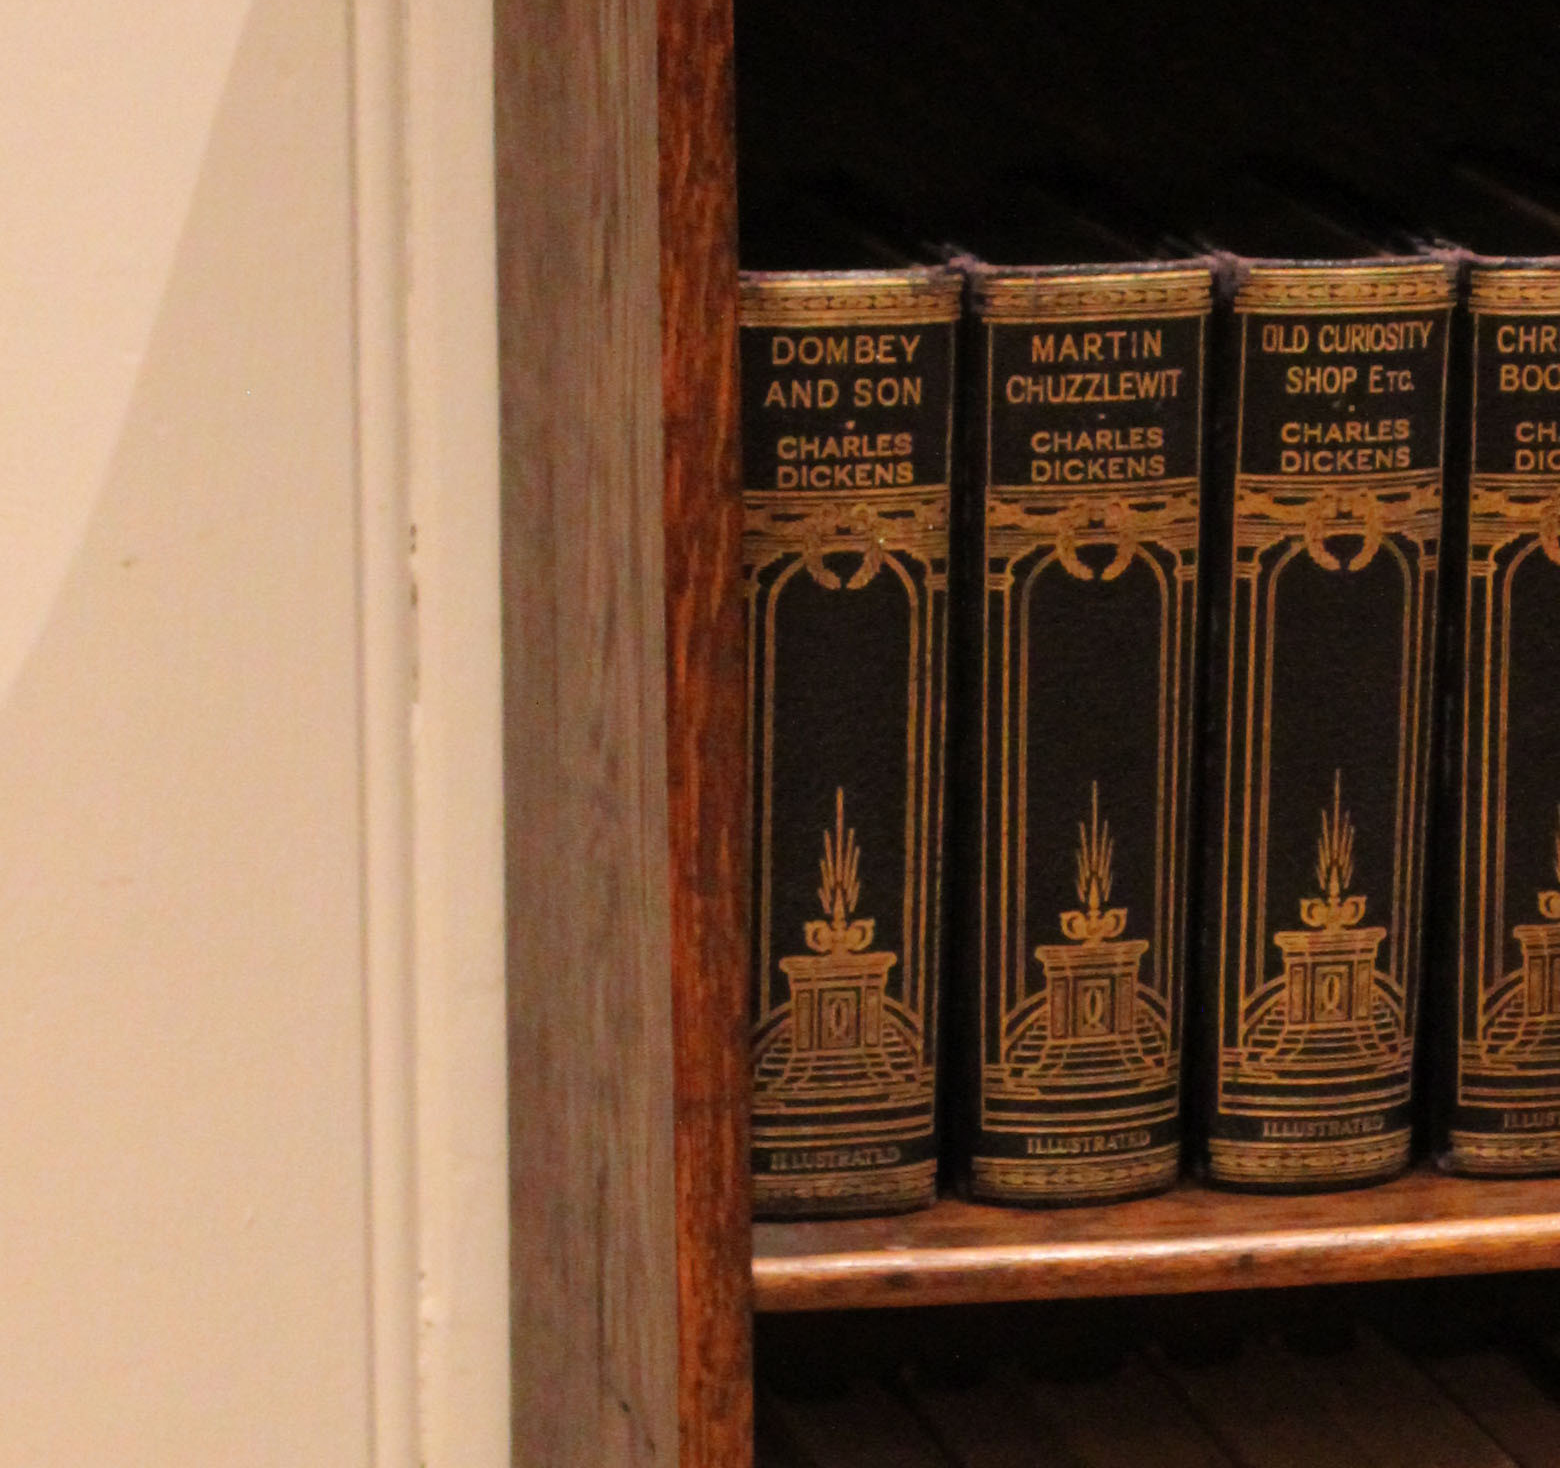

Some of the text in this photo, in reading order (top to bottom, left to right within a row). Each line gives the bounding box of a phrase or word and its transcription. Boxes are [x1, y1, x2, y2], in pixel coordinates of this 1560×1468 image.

[773, 335, 920, 365] DOMBEY
[1031, 331, 1163, 363] MARTIN
[1262, 322, 1433, 353] OLD CURIOSITY
[764, 378, 921, 408] AND SON
[1006, 369, 1182, 403] CHUZZLEWIT
[1286, 366, 1357, 394] SHOP
[1031, 427, 1164, 453] CHARLES
[1281, 418, 1410, 444] CHARLES
[777, 433, 912, 460] CHARLES
[1281, 447, 1410, 472] DICKENS
[777, 462, 913, 488] DICKENS
[1031, 455, 1165, 482] DICKENS
[1262, 1114, 1385, 1137] ILLUSTRATED
[1027, 1131, 1151, 1155] ILLUSTRATED
